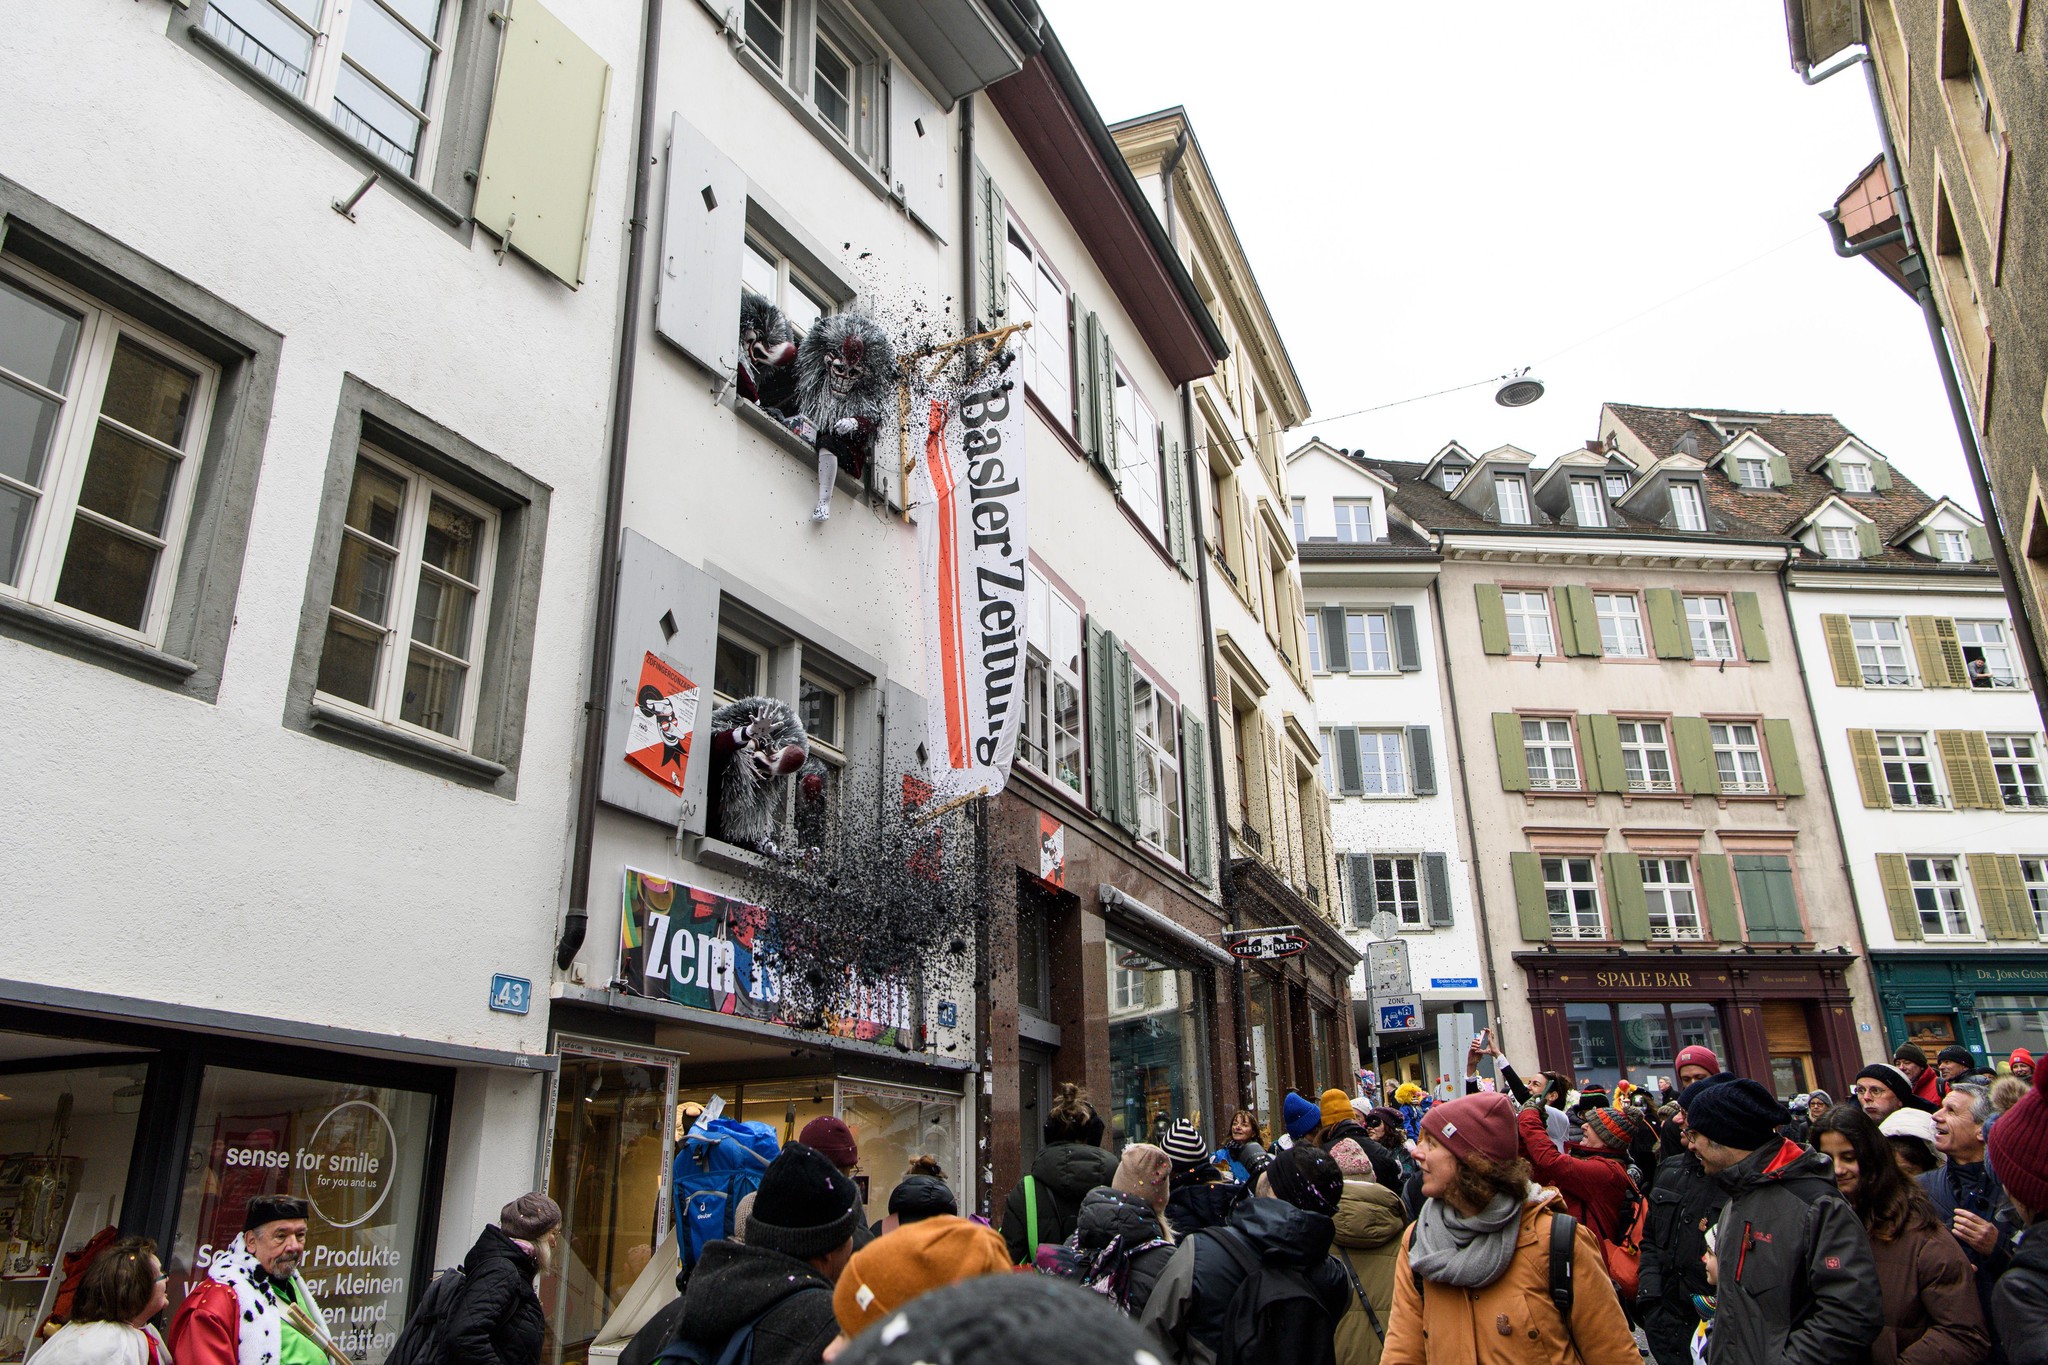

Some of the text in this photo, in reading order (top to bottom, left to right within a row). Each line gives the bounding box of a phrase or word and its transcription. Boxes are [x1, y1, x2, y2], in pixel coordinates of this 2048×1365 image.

[959, 386, 1026, 768] Basler Zeitung
[645, 911, 735, 994] Zem
[1234, 942, 1303, 953] THOMMEN
[1596, 972, 1692, 987] SPALE BAR
[499, 982, 523, 1007] 43
[941, 1004, 954, 1023] 45
[226, 1148, 379, 1174] sense for smile
[317, 1175, 330, 1185] for
[333, 1178, 349, 1189] you
[350, 1177, 365, 1188] and
[314, 1245, 401, 1267] Produkte
[335, 1273, 404, 1296] kleinen
[351, 1300, 388, 1324] und
